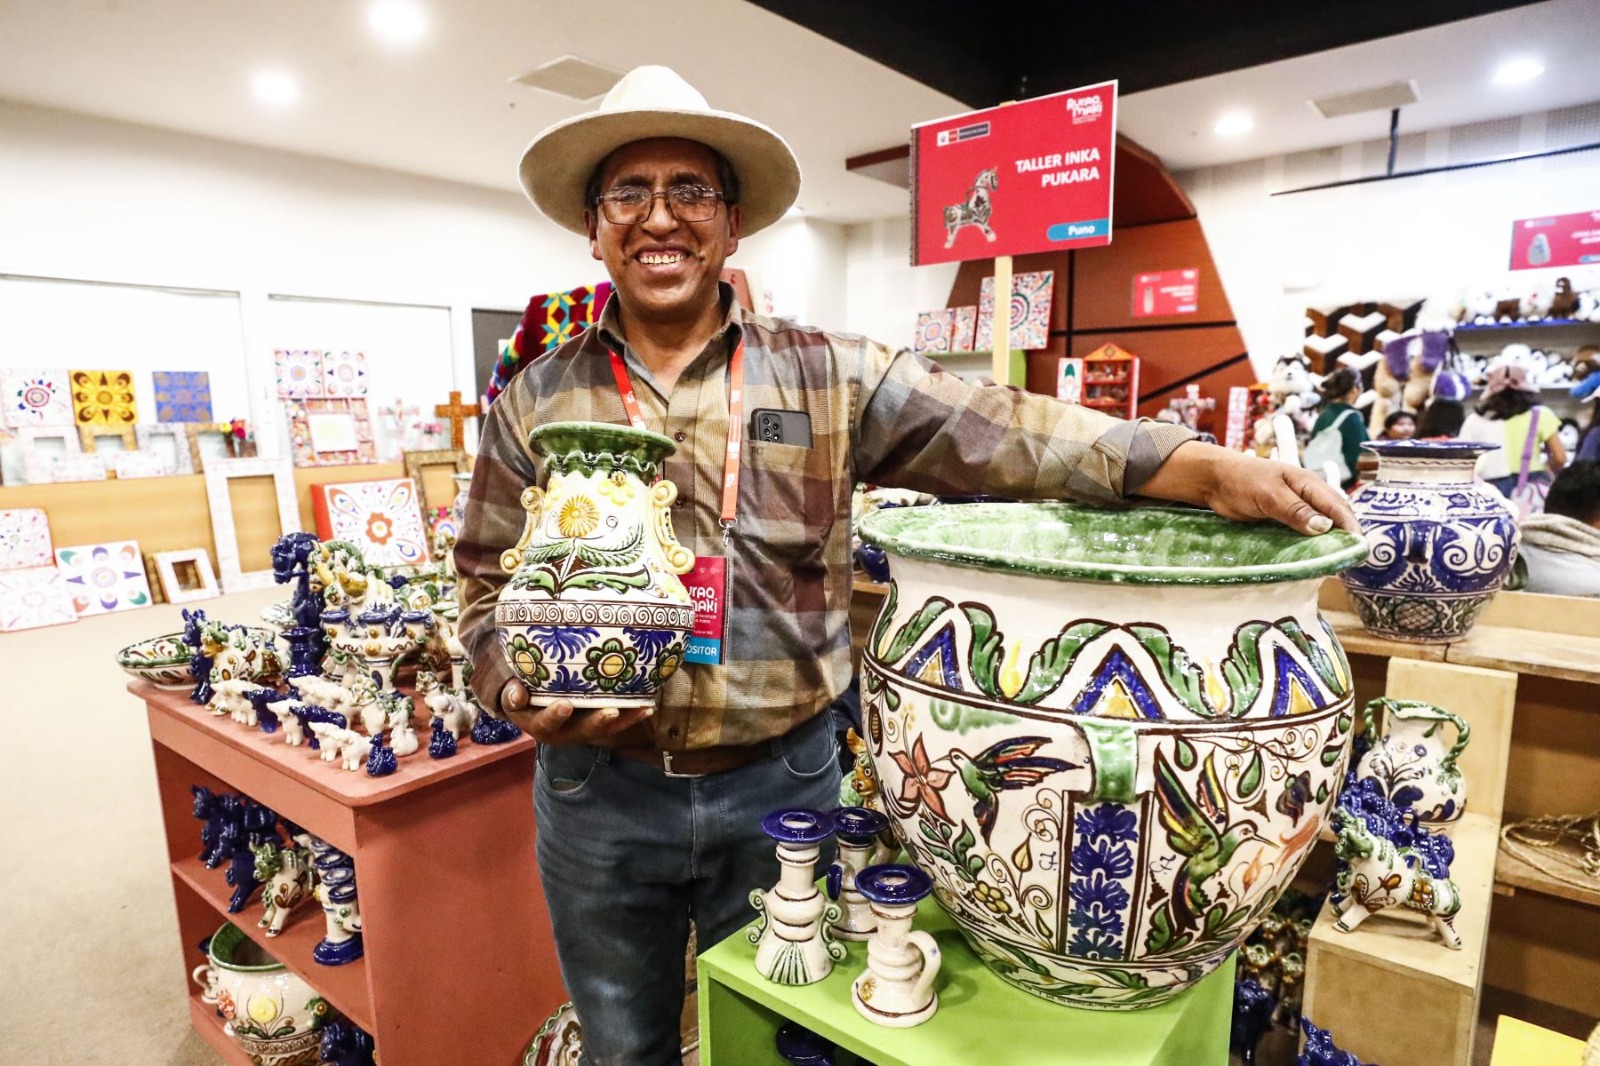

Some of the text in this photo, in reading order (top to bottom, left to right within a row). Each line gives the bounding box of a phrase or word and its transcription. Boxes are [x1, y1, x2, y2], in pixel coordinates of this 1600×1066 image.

[1014, 147, 1101, 174] TALLER INKA
[1041, 166, 1100, 188] PUKARA
[1068, 225, 1096, 236] Puno
[687, 645, 717, 656] OSITOR
